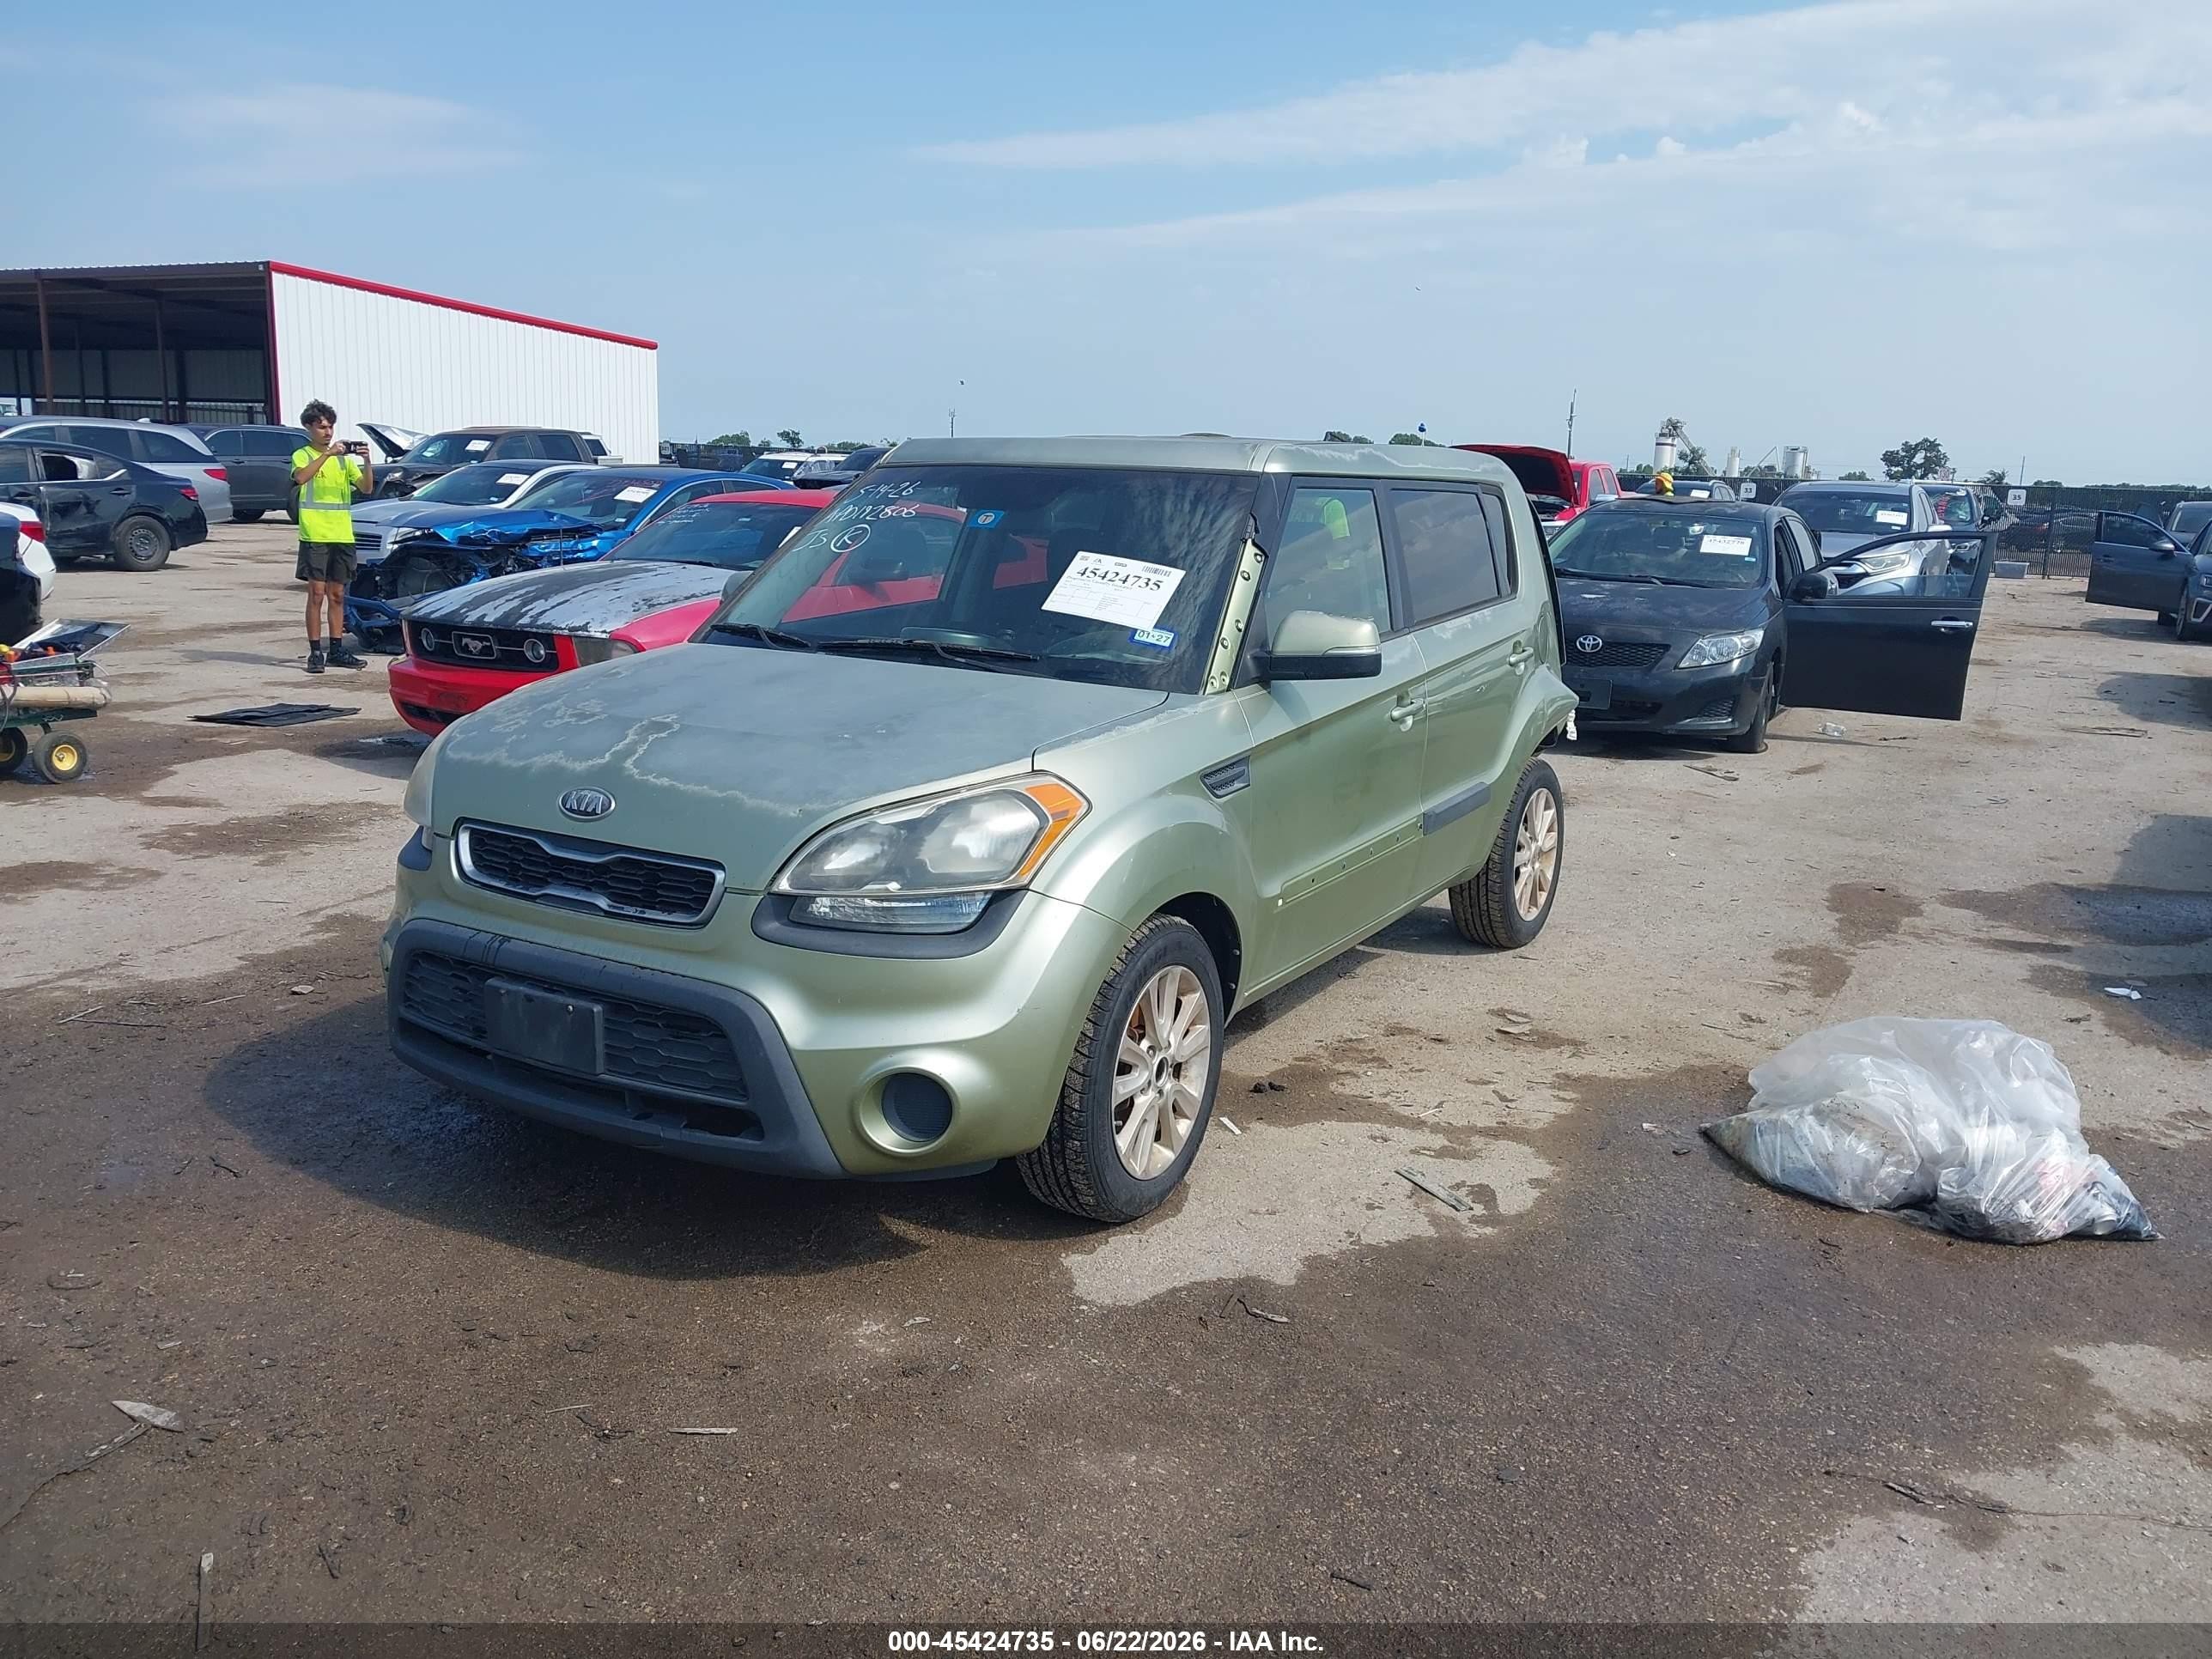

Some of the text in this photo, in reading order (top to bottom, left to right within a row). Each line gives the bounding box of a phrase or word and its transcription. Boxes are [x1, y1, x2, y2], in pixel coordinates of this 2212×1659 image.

[844, 481, 921, 504] 5-14-26
[1076, 566, 1164, 592] 45424735
[564, 789, 603, 815] KIA
